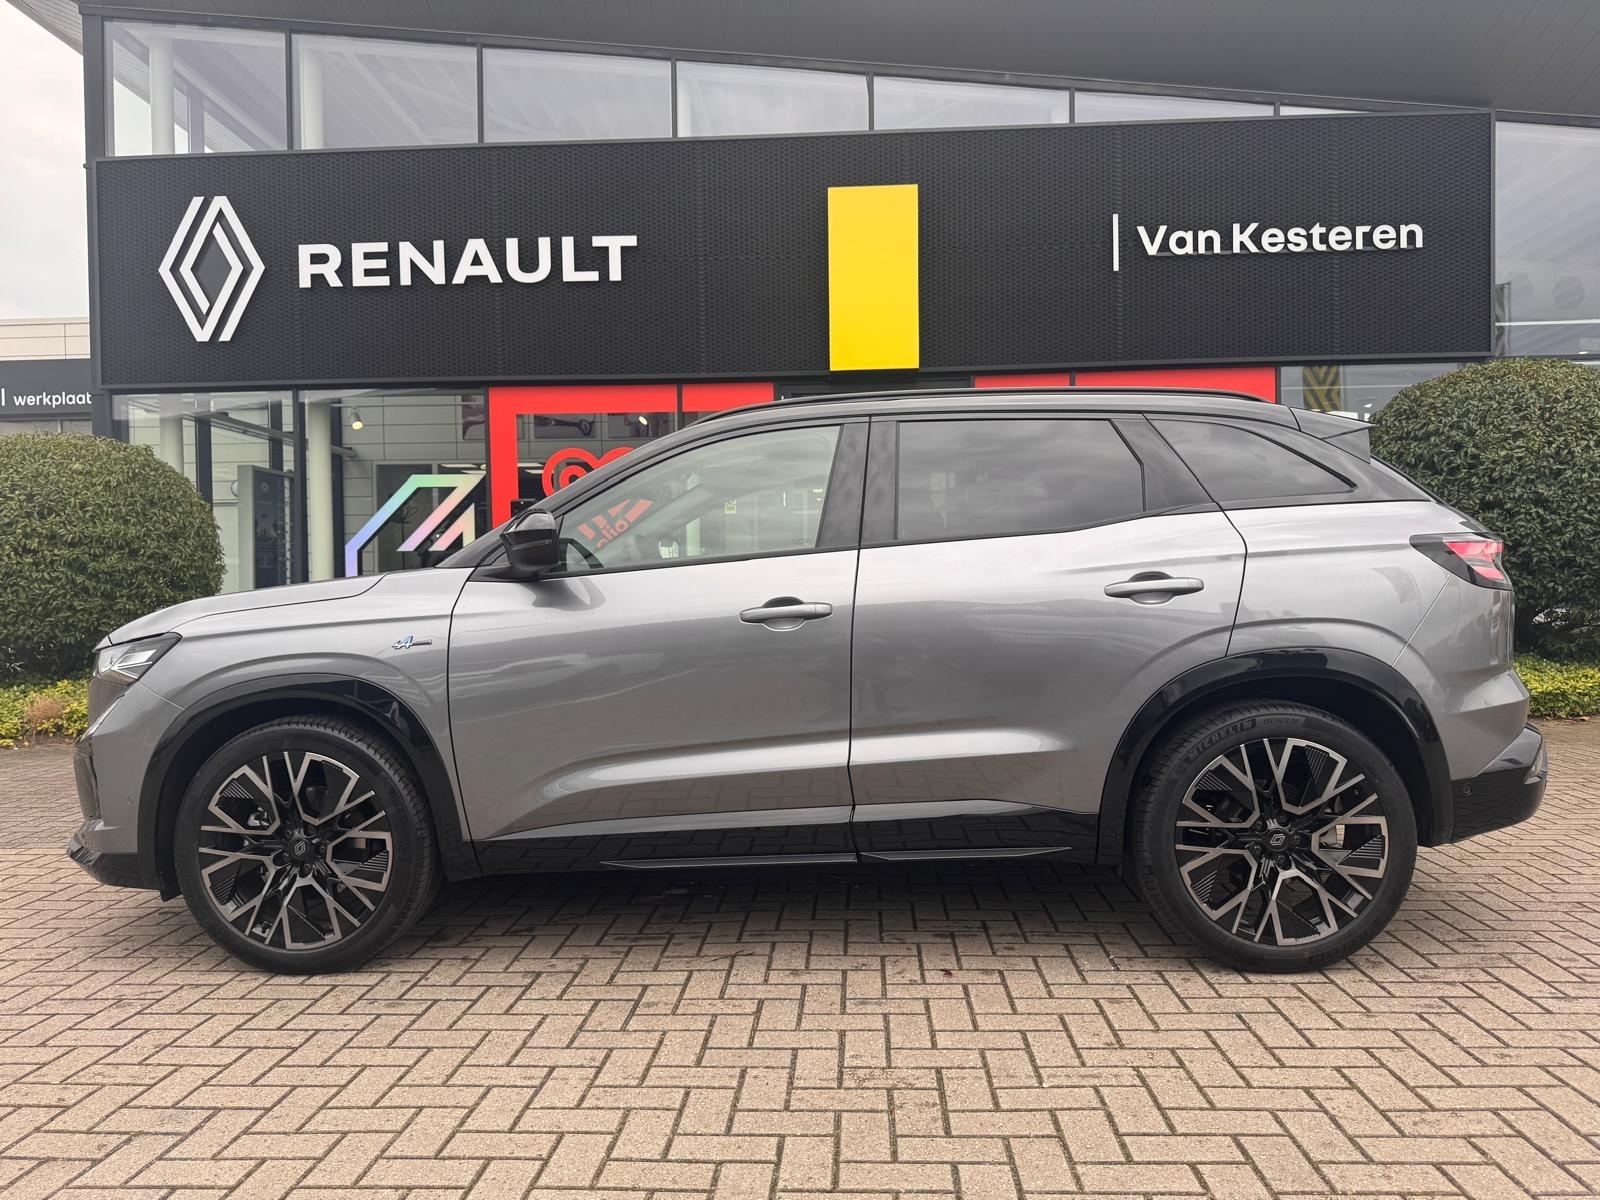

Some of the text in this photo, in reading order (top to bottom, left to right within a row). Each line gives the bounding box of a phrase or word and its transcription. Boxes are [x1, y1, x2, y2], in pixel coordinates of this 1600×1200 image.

[1136, 222, 1424, 256] Van Kesteren
[298, 235, 638, 289] RENAULT
